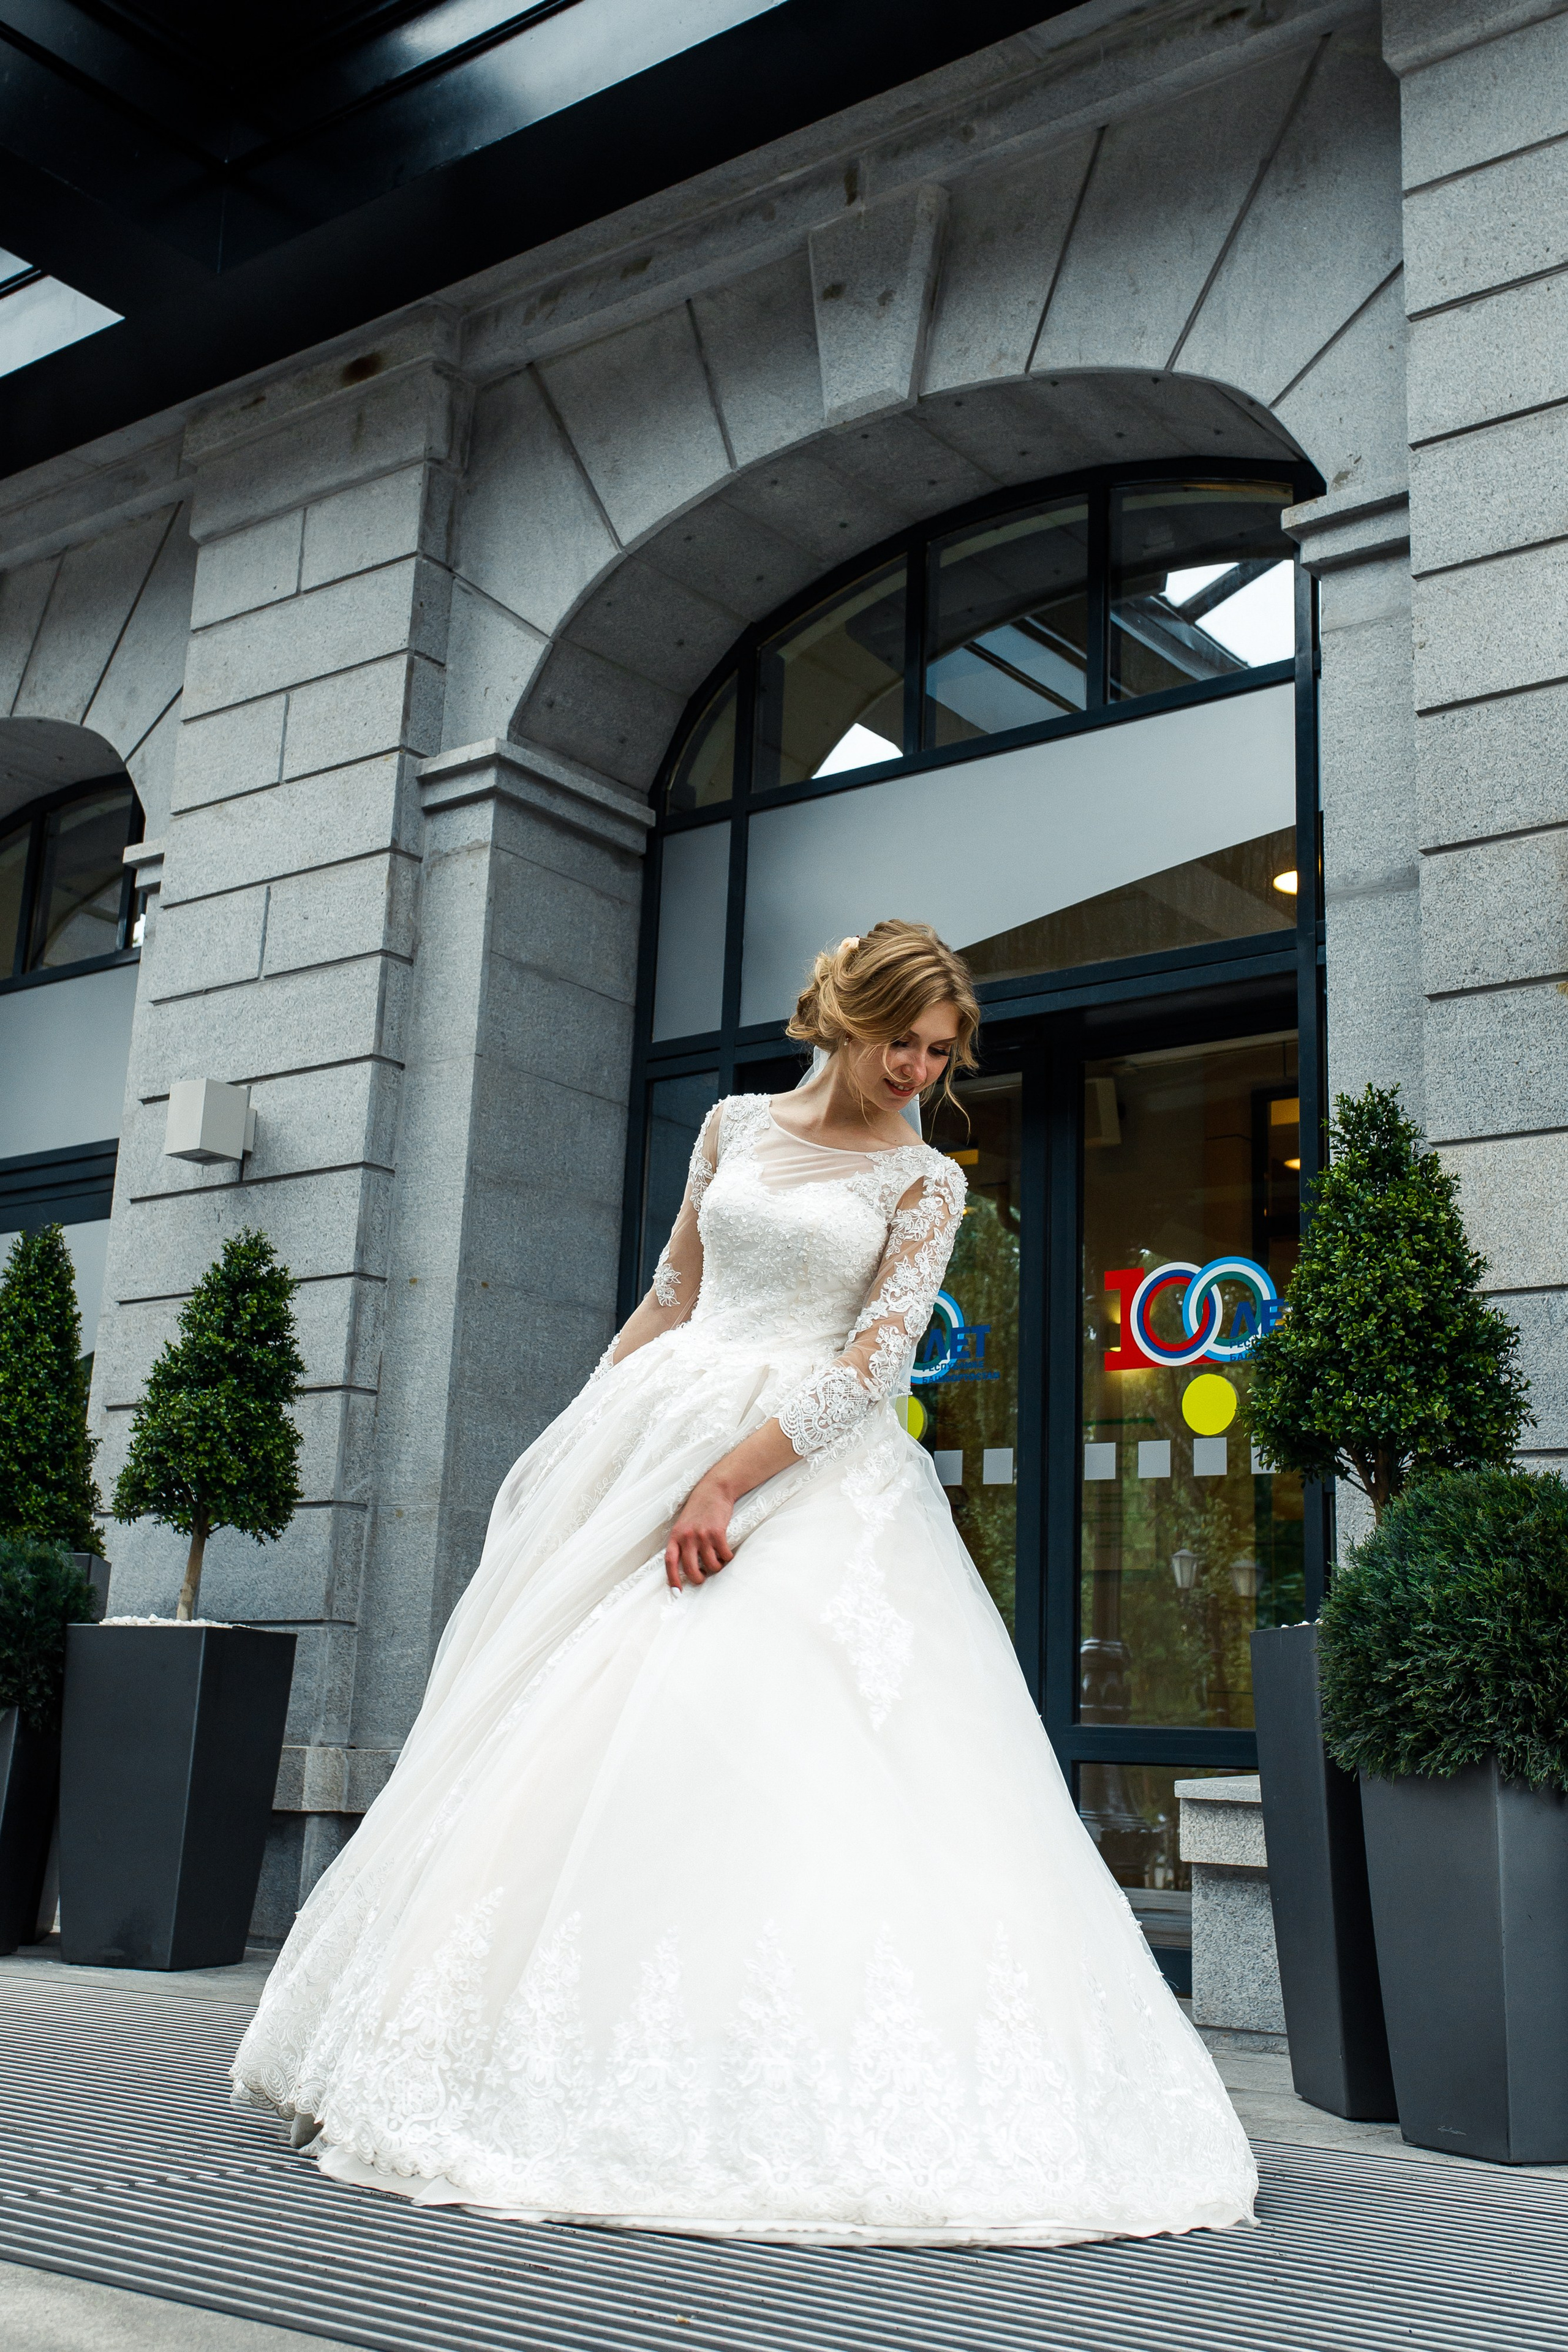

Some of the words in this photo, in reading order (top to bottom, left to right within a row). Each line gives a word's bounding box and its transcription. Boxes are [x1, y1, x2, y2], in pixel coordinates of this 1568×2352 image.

[923, 1324, 991, 1362] ЛЕТ
[1104, 1256, 1277, 1371] 100
[1229, 1298, 1289, 1338] ЛЕ
